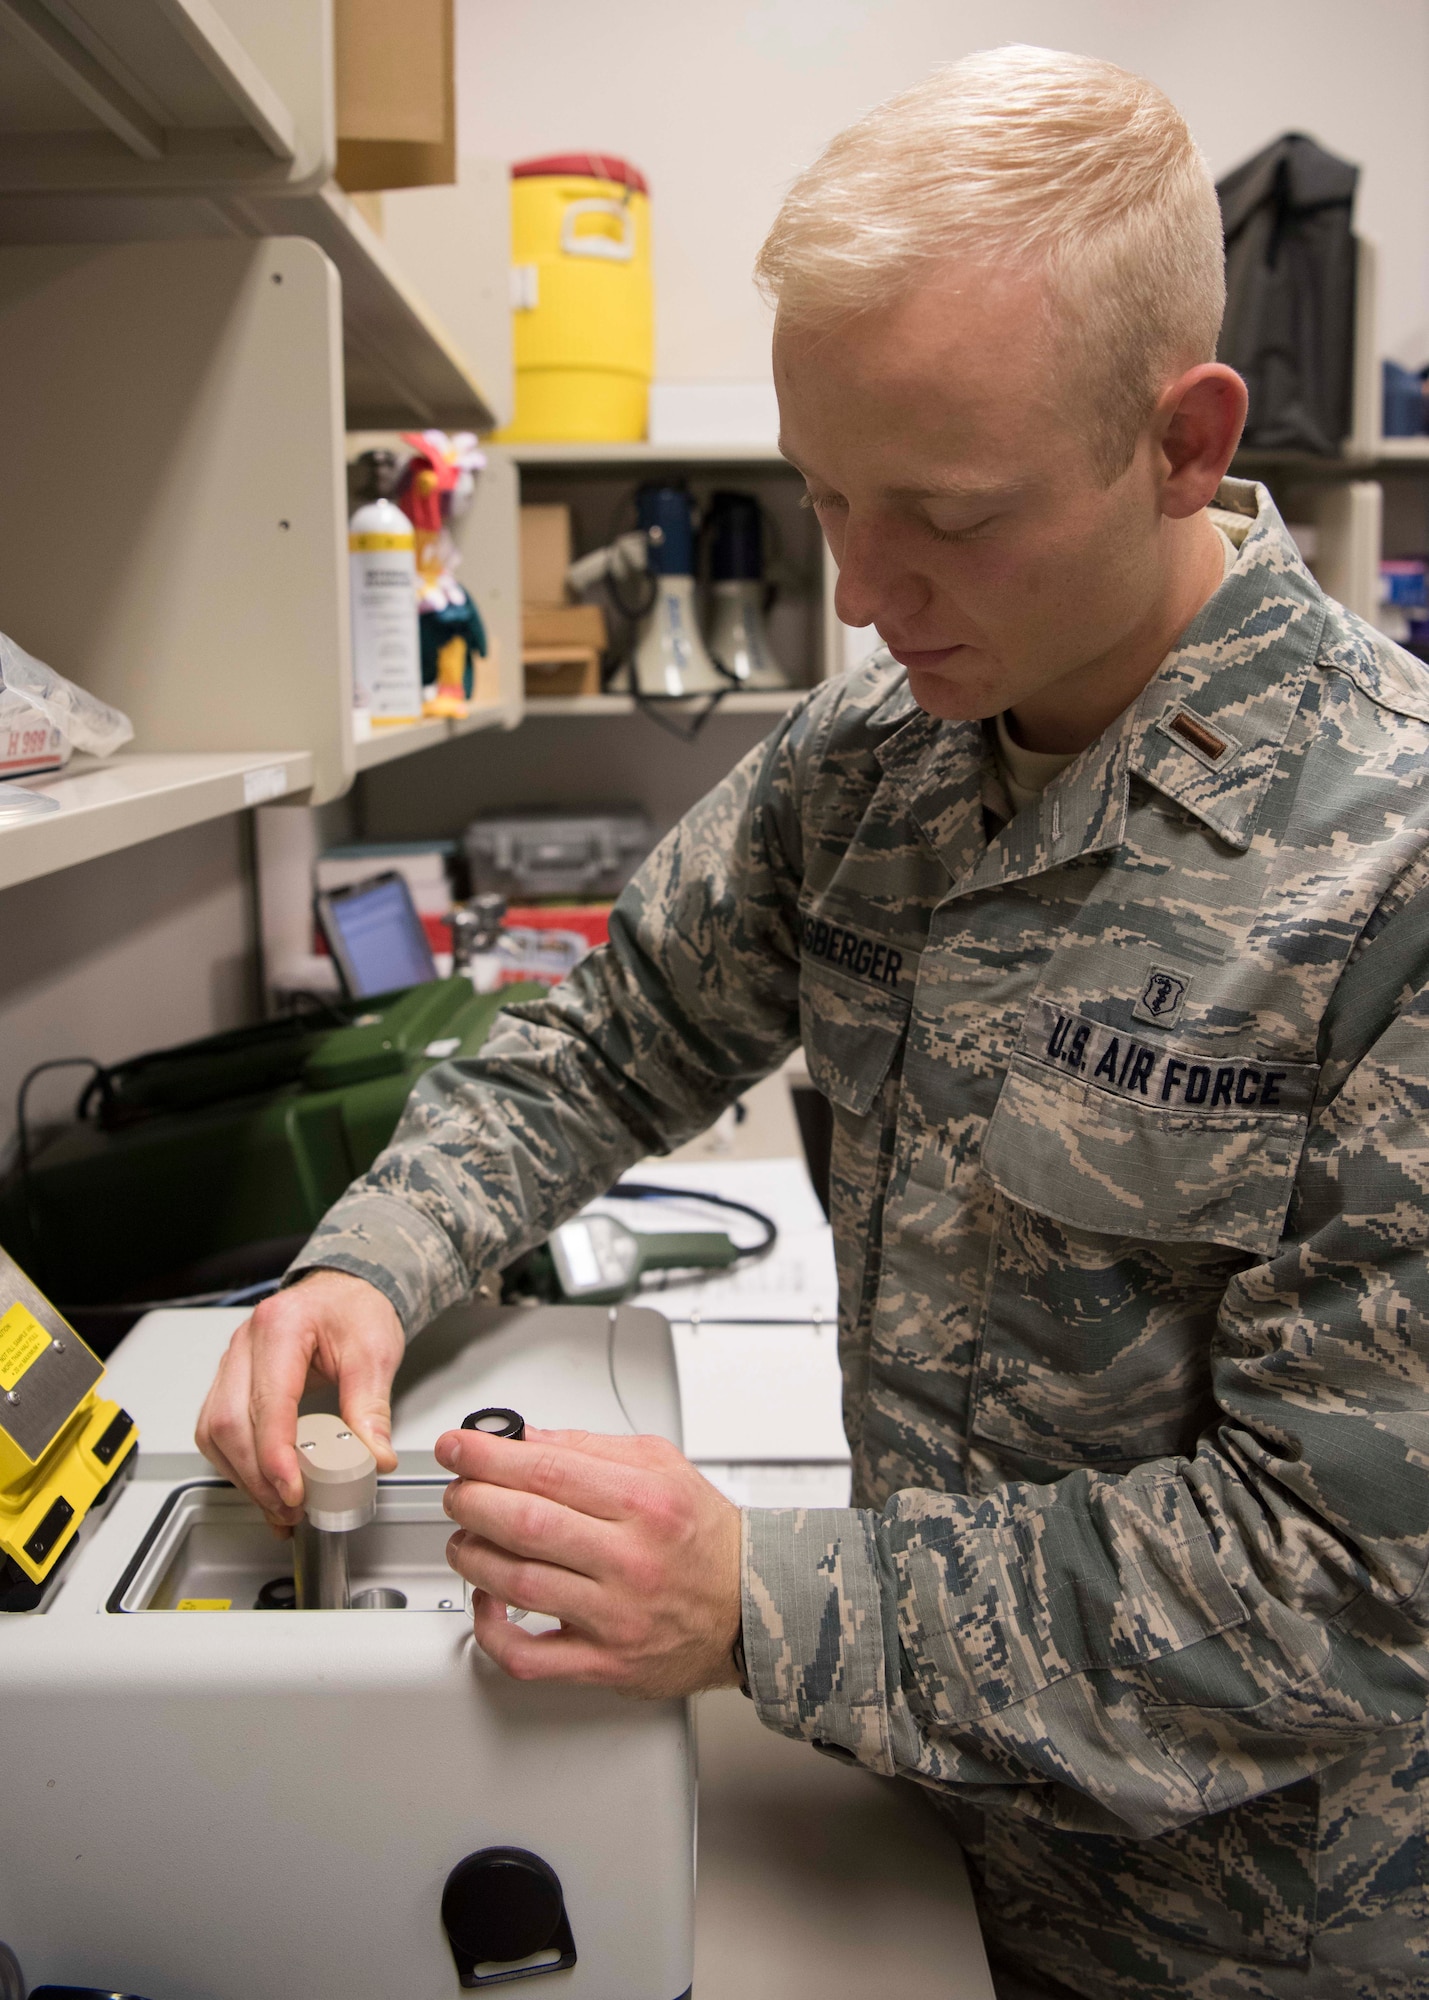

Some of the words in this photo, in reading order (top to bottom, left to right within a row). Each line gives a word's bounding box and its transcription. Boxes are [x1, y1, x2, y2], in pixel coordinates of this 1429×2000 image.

[7, 731, 20, 757] H
[803, 917, 903, 988] SBERGER
[1048, 1015, 1092, 1072] U.S.
[1094, 1036, 1156, 1096] AIR
[1161, 1057, 1287, 1107] FORCE
[0, 1323, 12, 1338] UTION
